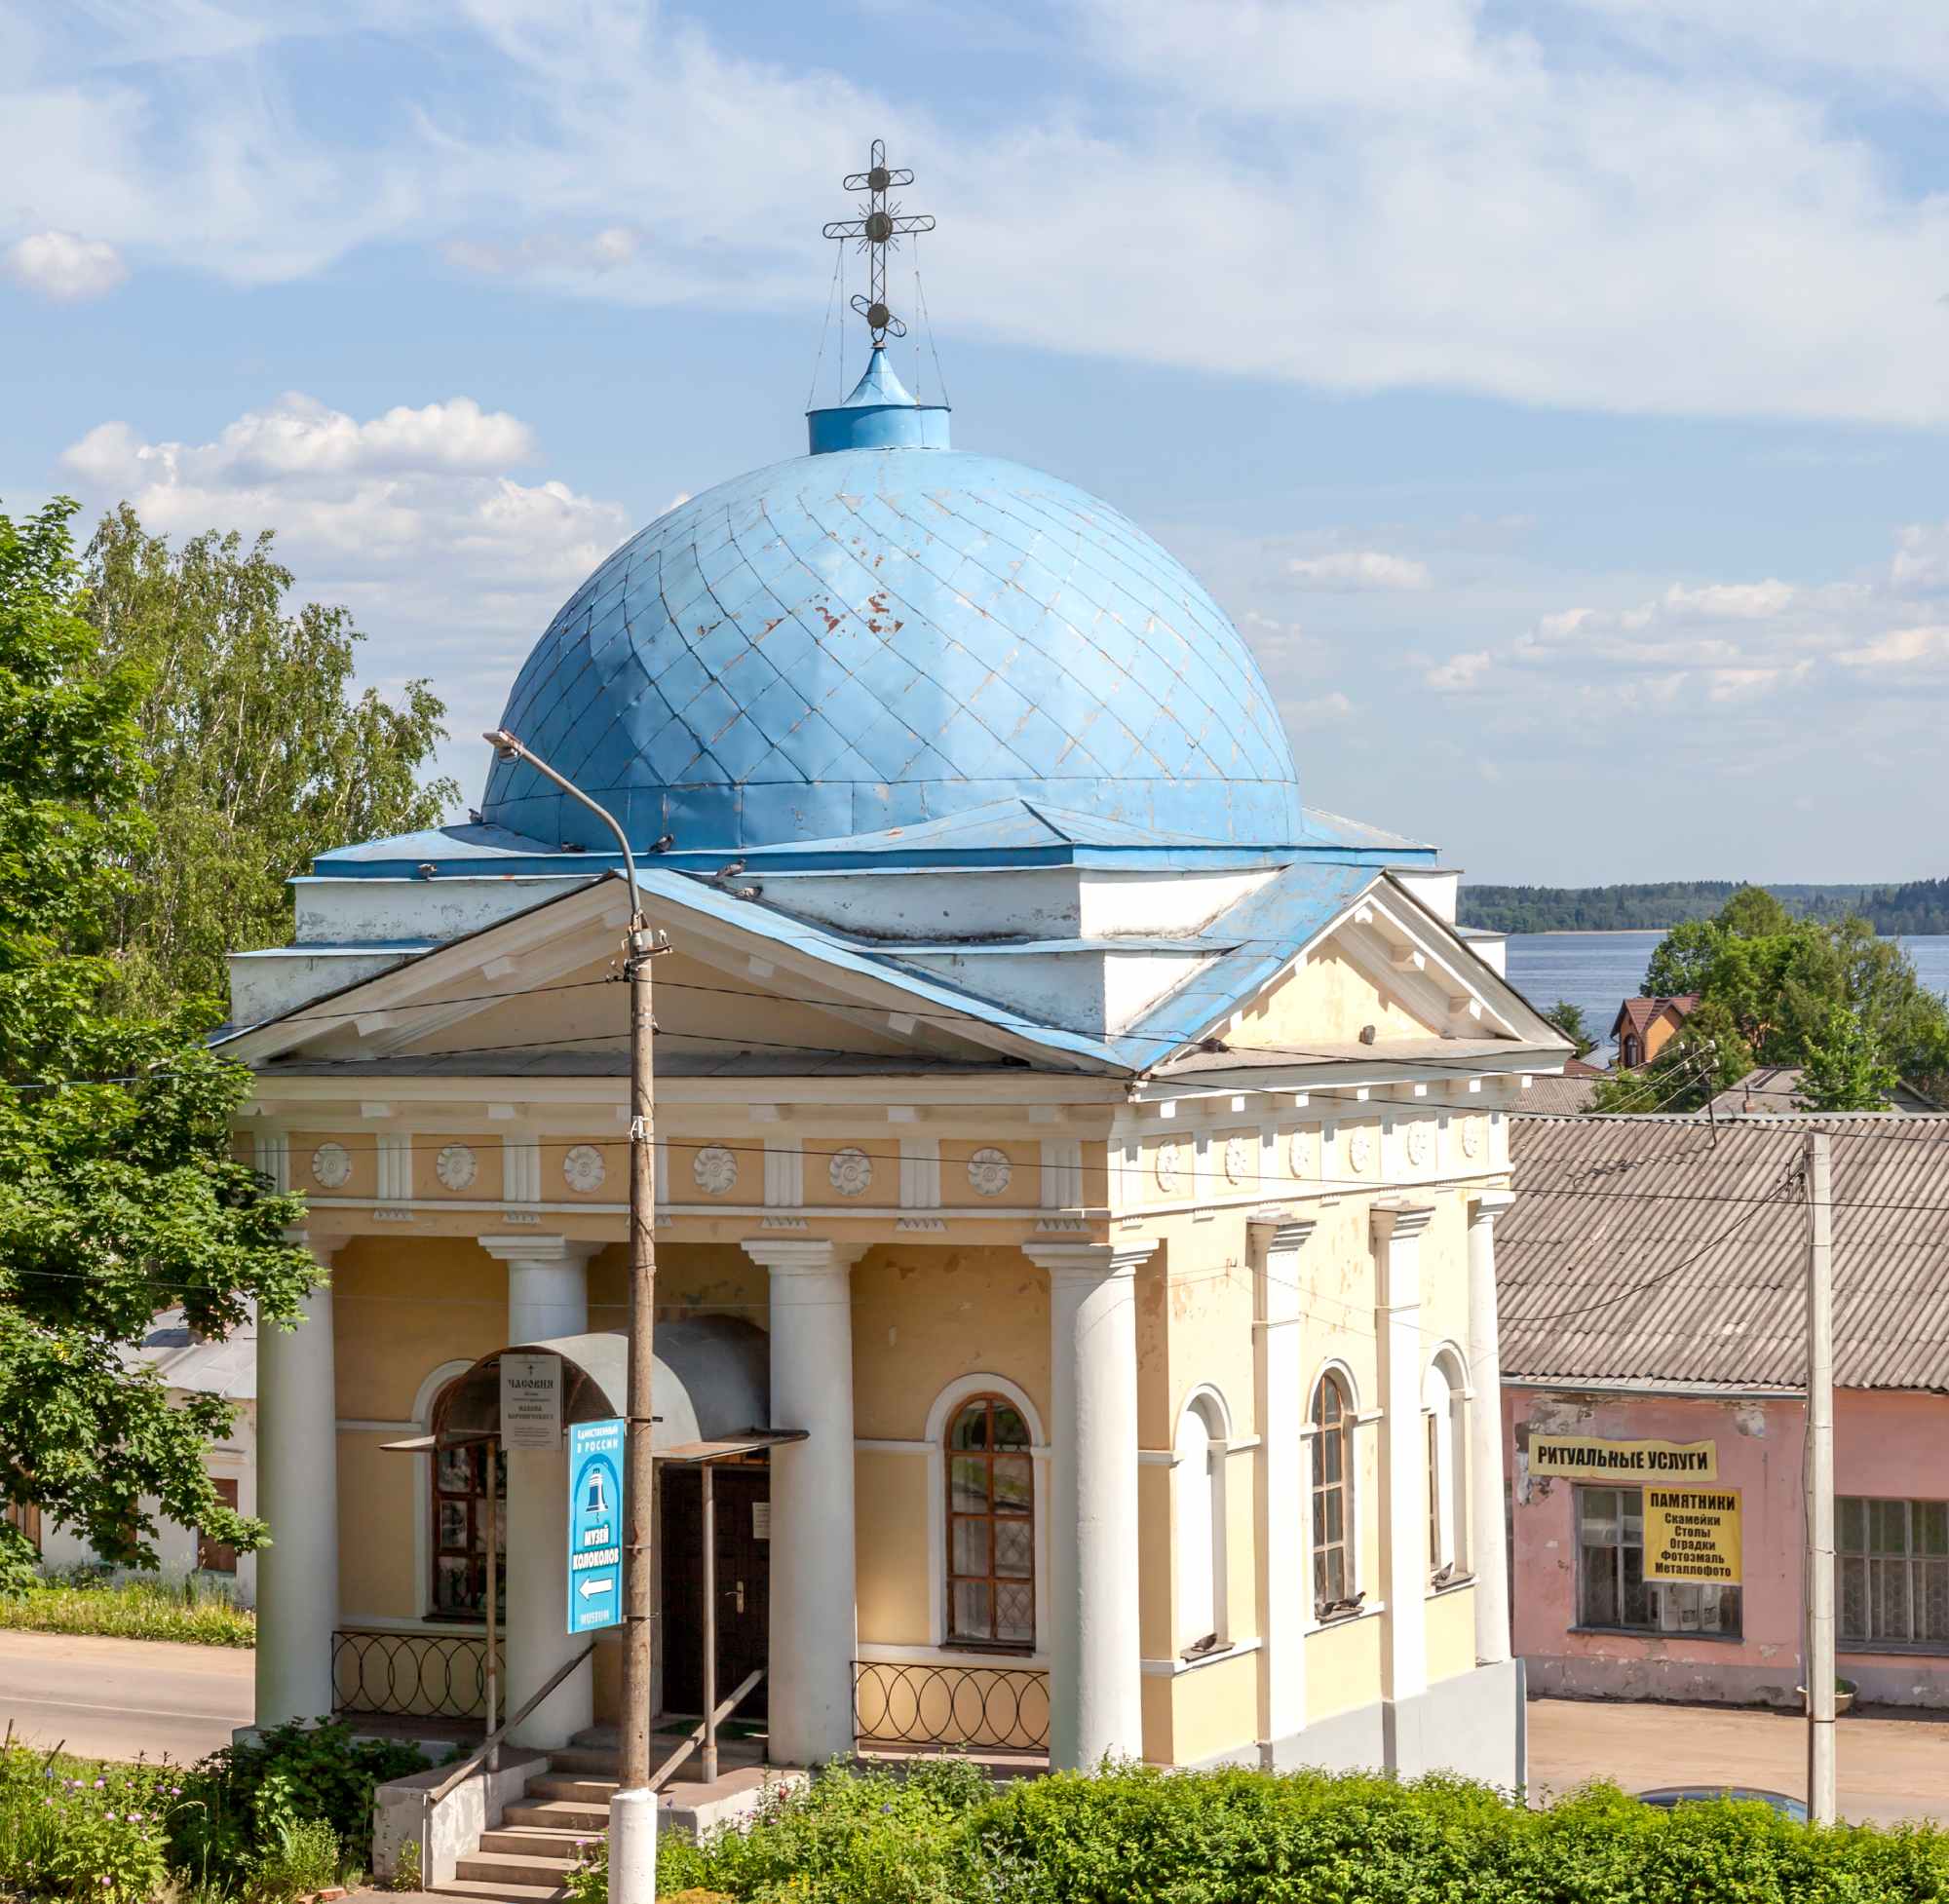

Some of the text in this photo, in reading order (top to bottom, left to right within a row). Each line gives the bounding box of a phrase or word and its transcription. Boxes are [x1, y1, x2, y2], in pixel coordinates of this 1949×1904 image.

[585, 1438, 619, 1452] РОССИИ
[1538, 1446, 1707, 1469] РИТУАЛЬНЫЕ УСЛУГИ
[1651, 1493, 1735, 1510] ПАМЯТНИКИ
[1664, 1512, 1721, 1526] Скамейки
[585, 1524, 609, 1546] МУЗЕЙ
[1675, 1526, 1710, 1538] Столы
[1669, 1538, 1716, 1551] Оградки
[572, 1547, 619, 1571] КОЛОКОЛОВ
[1661, 1550, 1725, 1564] Фотоэмаль
[1655, 1562, 1732, 1577] Металлофото
